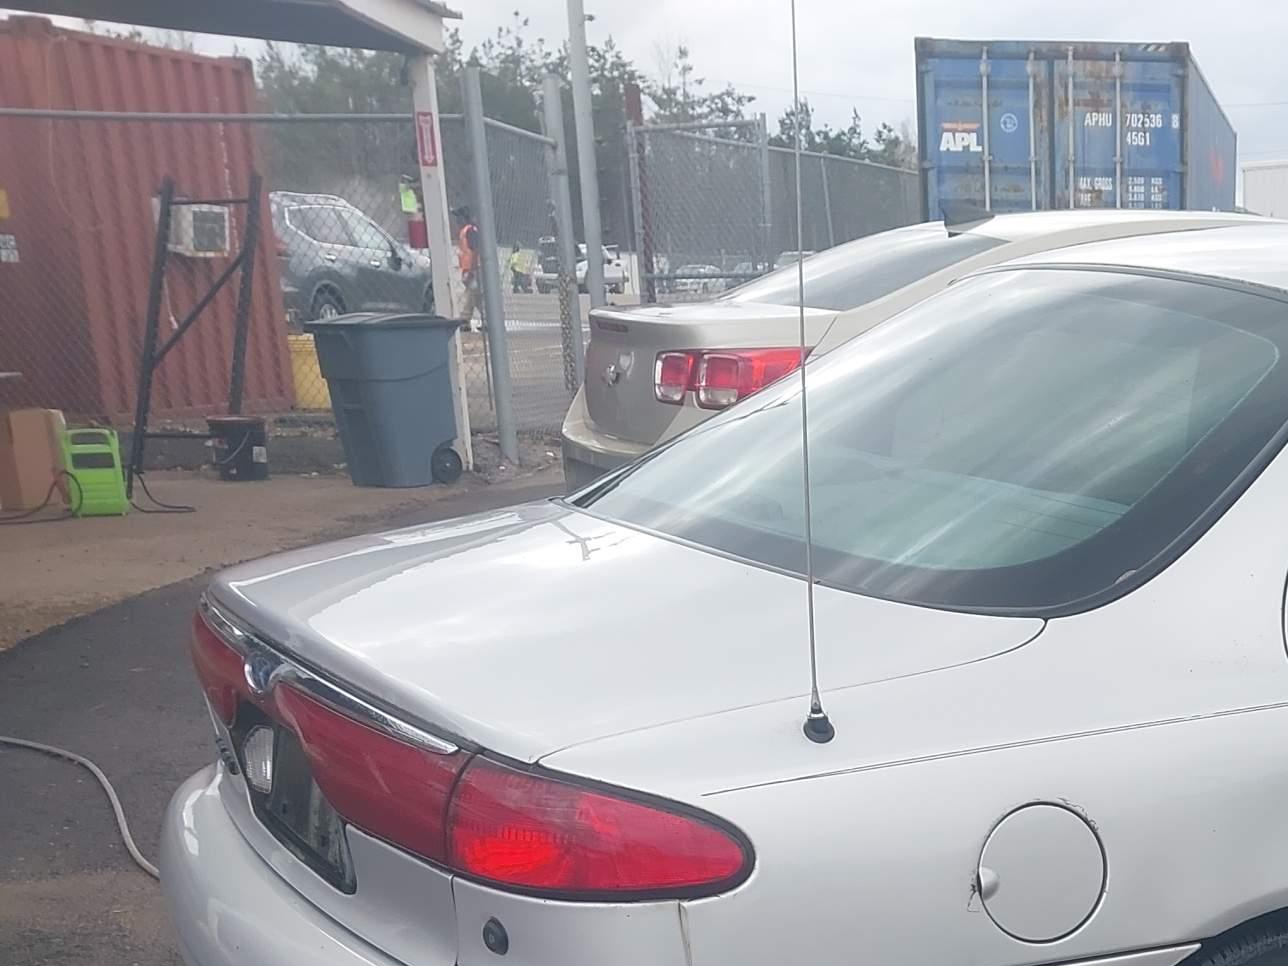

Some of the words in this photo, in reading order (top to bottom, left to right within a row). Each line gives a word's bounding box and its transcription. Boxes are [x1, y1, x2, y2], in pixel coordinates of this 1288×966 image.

[1084, 112, 1113, 127] APHU
[1125, 113, 1163, 128] 702536
[939, 131, 983, 152] APL
[1126, 131, 1151, 146] 45G1
